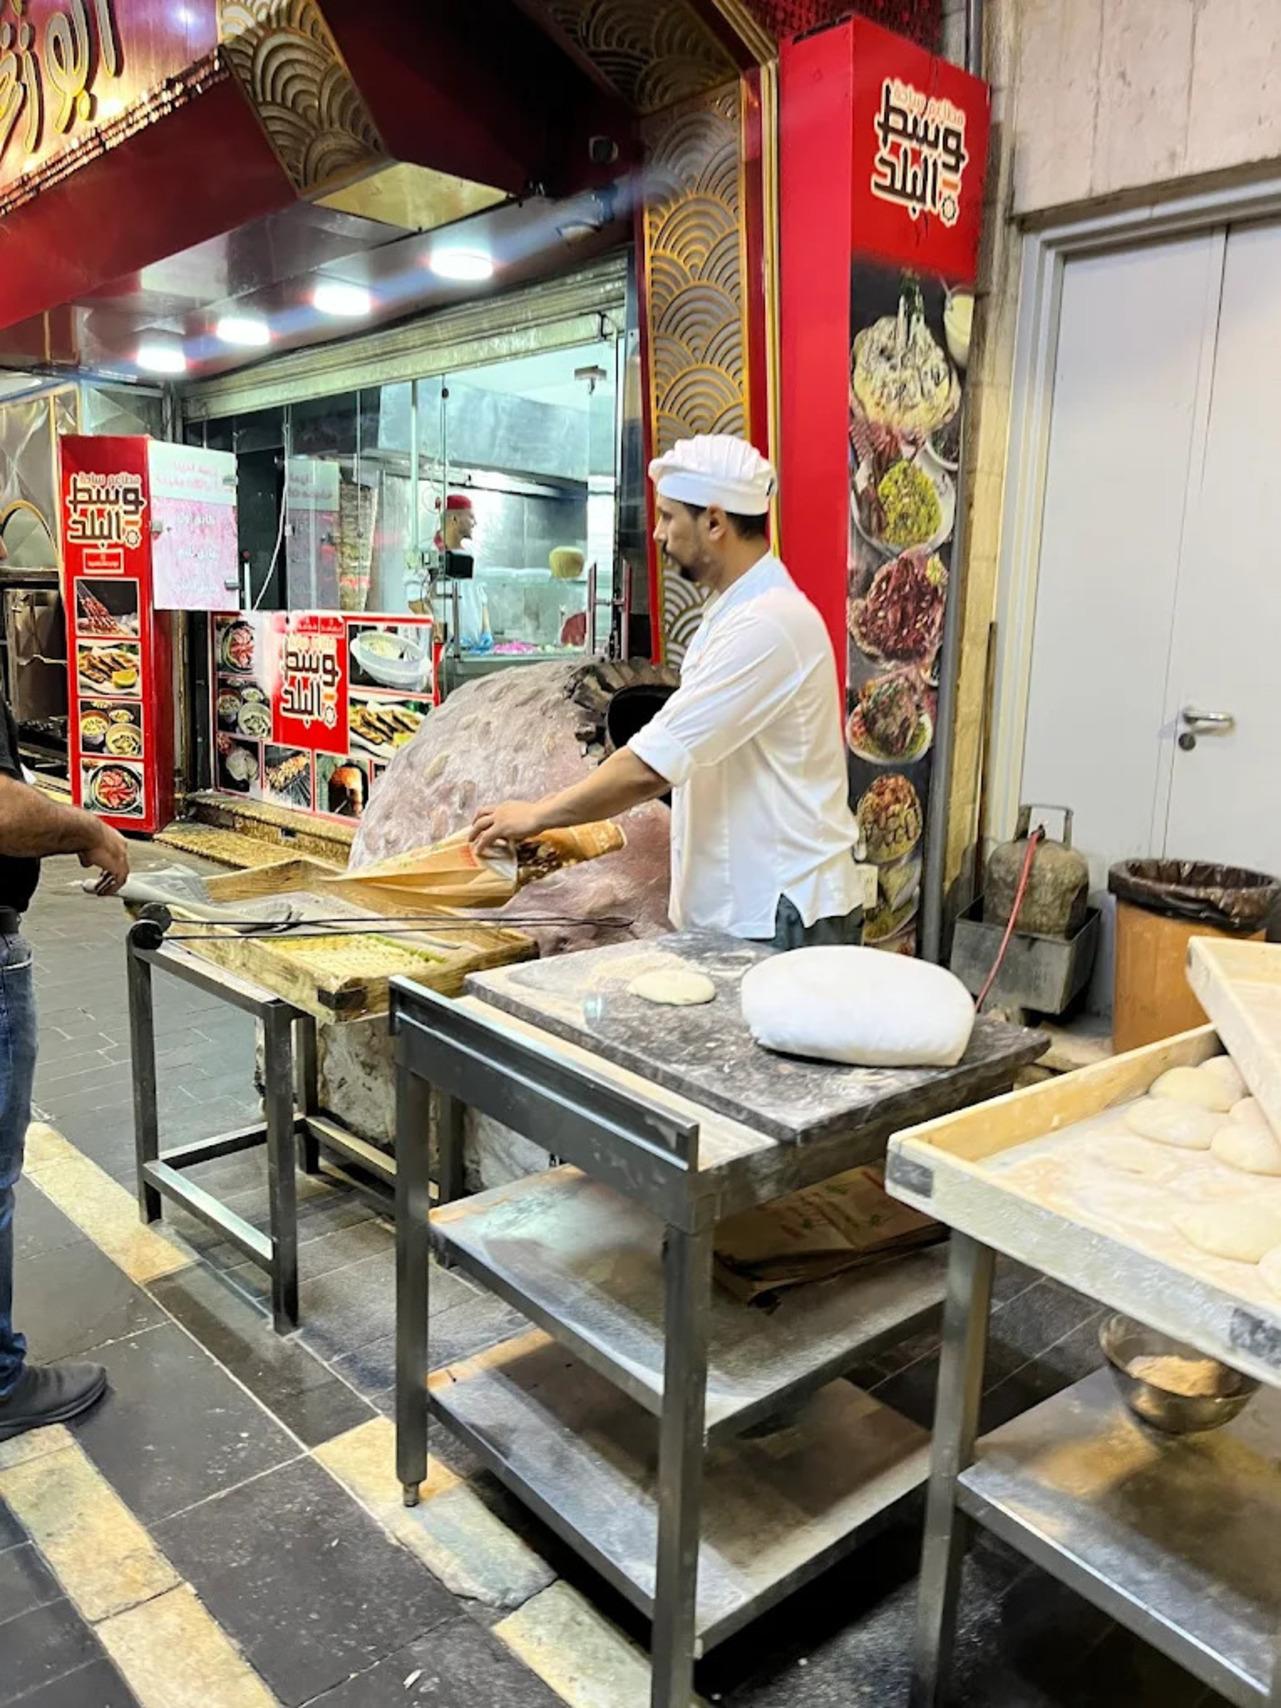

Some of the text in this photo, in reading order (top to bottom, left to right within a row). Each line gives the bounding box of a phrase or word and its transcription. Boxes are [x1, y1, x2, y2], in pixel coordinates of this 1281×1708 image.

[876, 83, 966, 174] وسط
[872, 146, 938, 216] البلد
[67, 475, 145, 516] وسط
[69, 509, 122, 548] البلد
[281, 637, 340, 688] وسط
[281, 677, 322, 725] البلد
